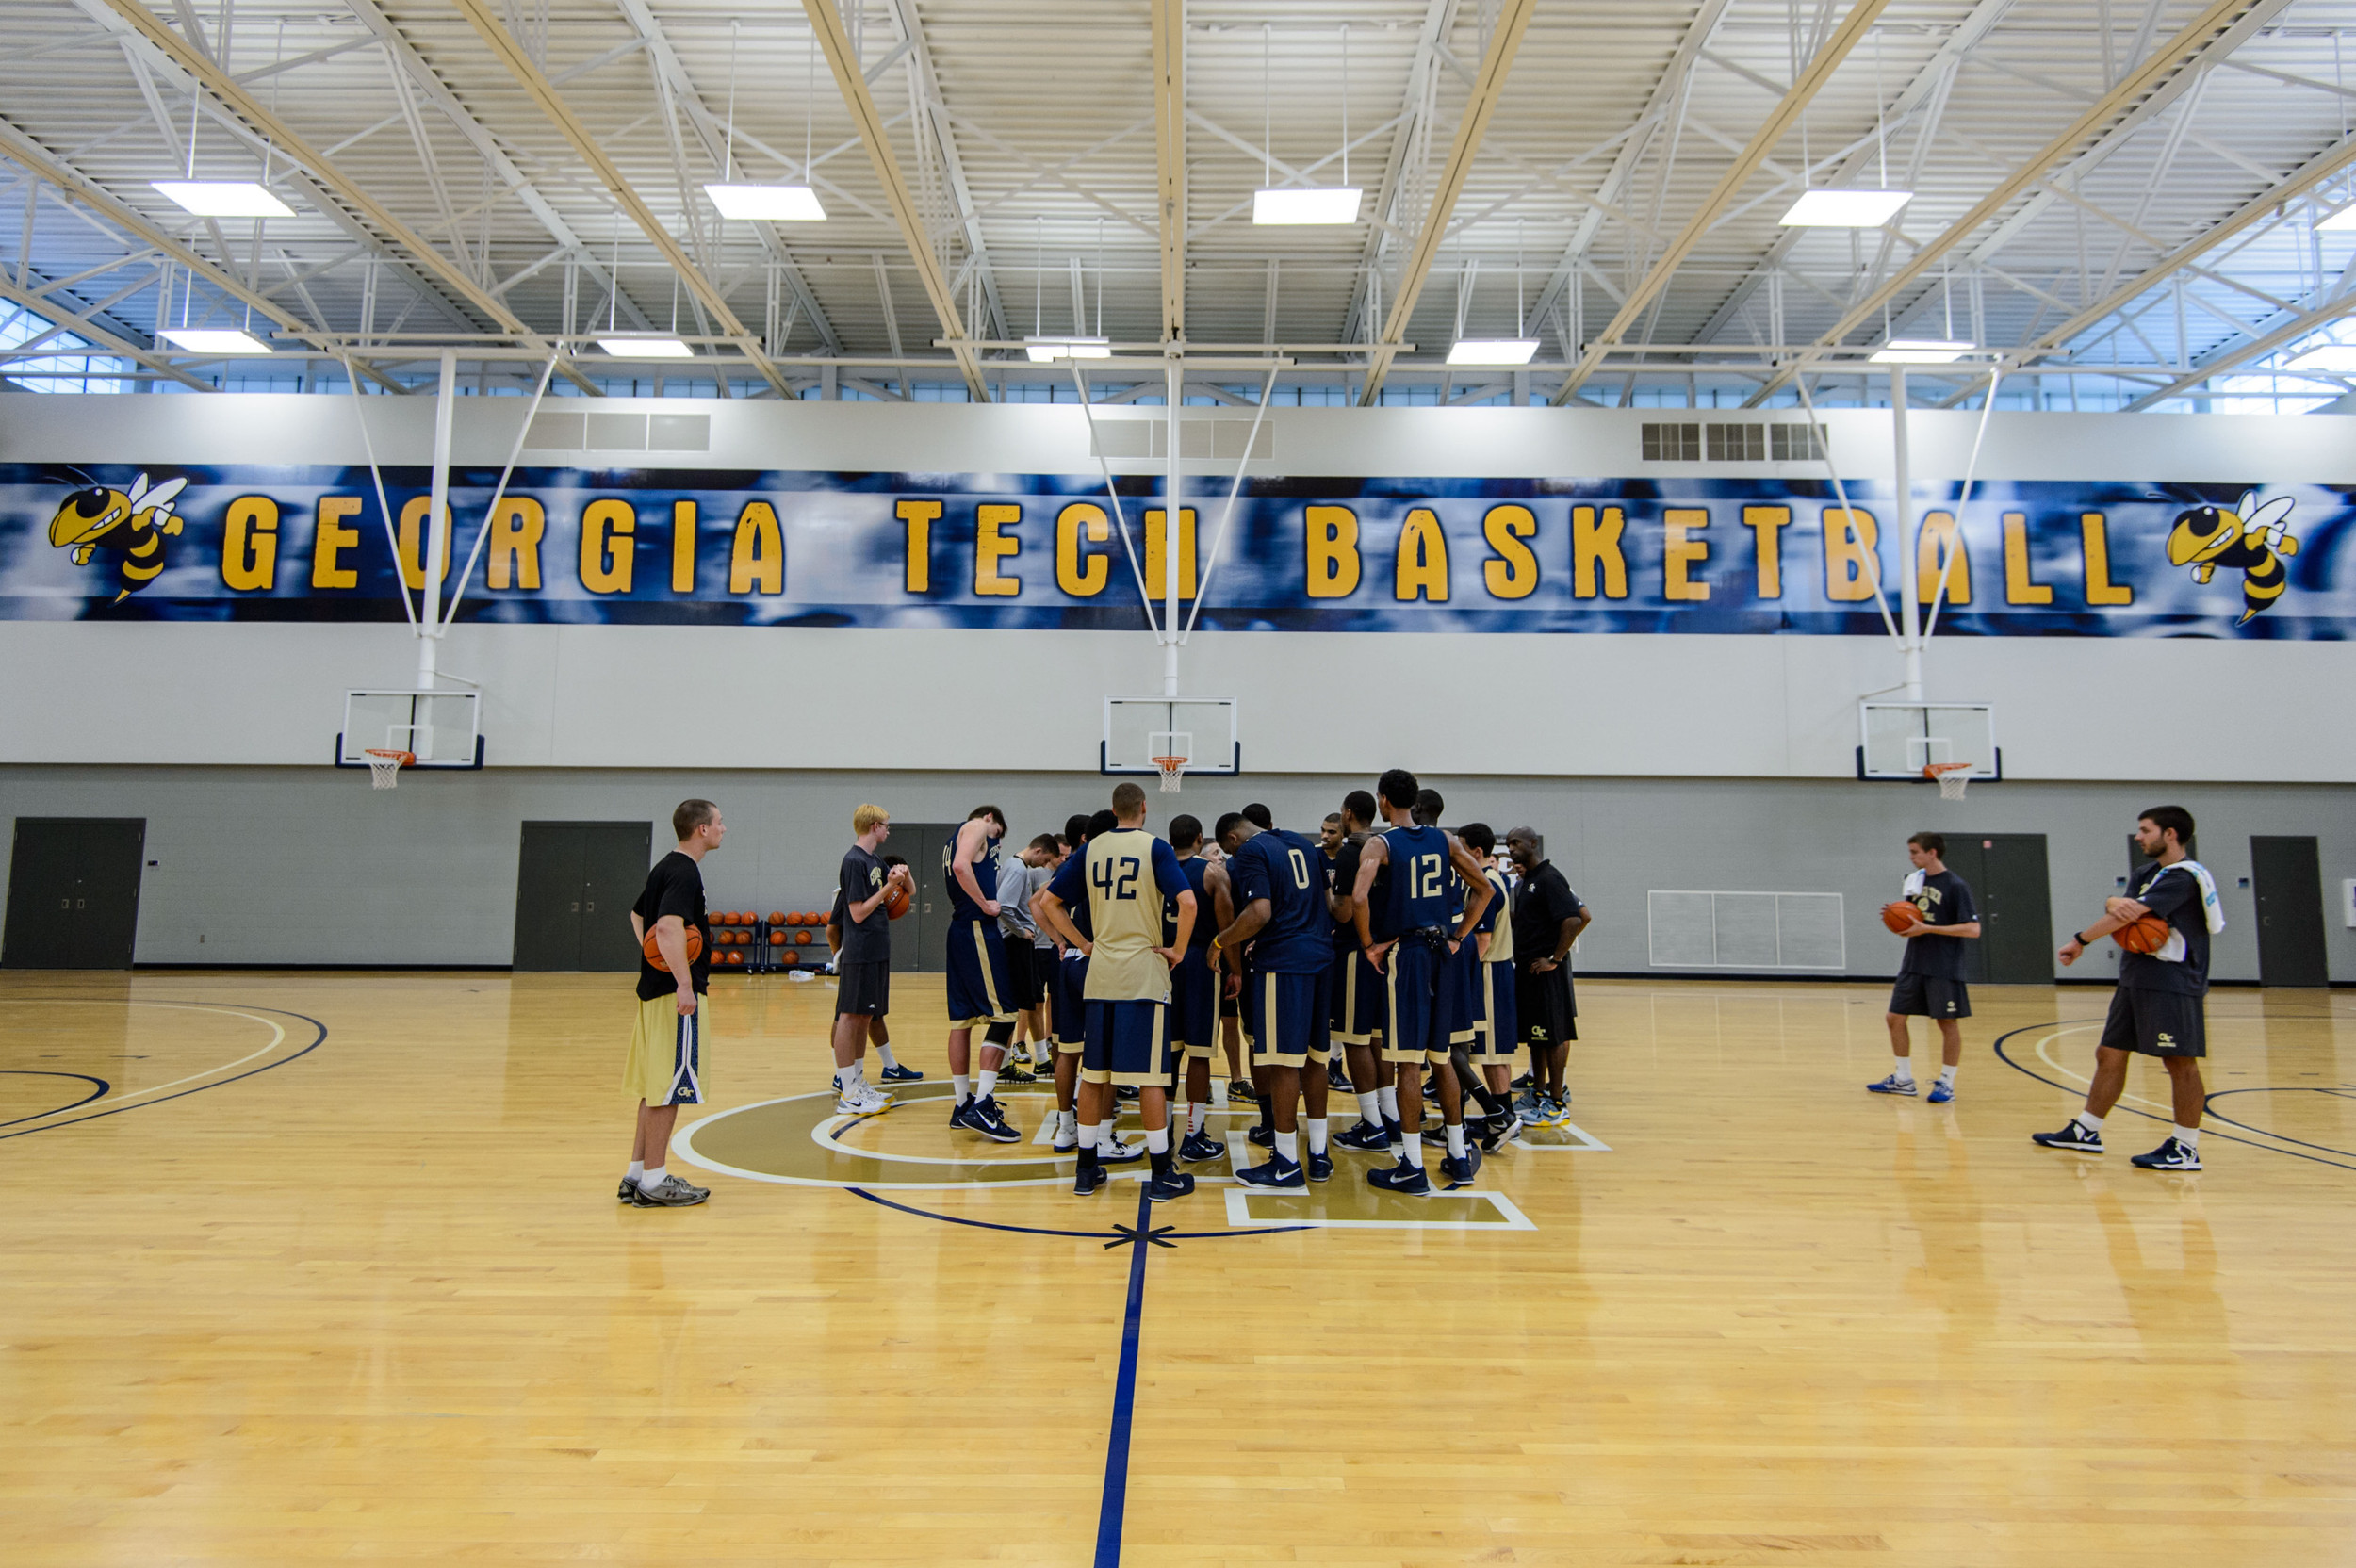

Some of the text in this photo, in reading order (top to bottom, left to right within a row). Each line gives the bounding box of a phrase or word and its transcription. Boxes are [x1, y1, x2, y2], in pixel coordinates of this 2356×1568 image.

[221, 495, 2133, 607] GEORGIA TECH BASKETBALL
[1092, 856, 1140, 900] 42
[1287, 848, 1311, 890] 0
[1410, 853, 1443, 899] 12
